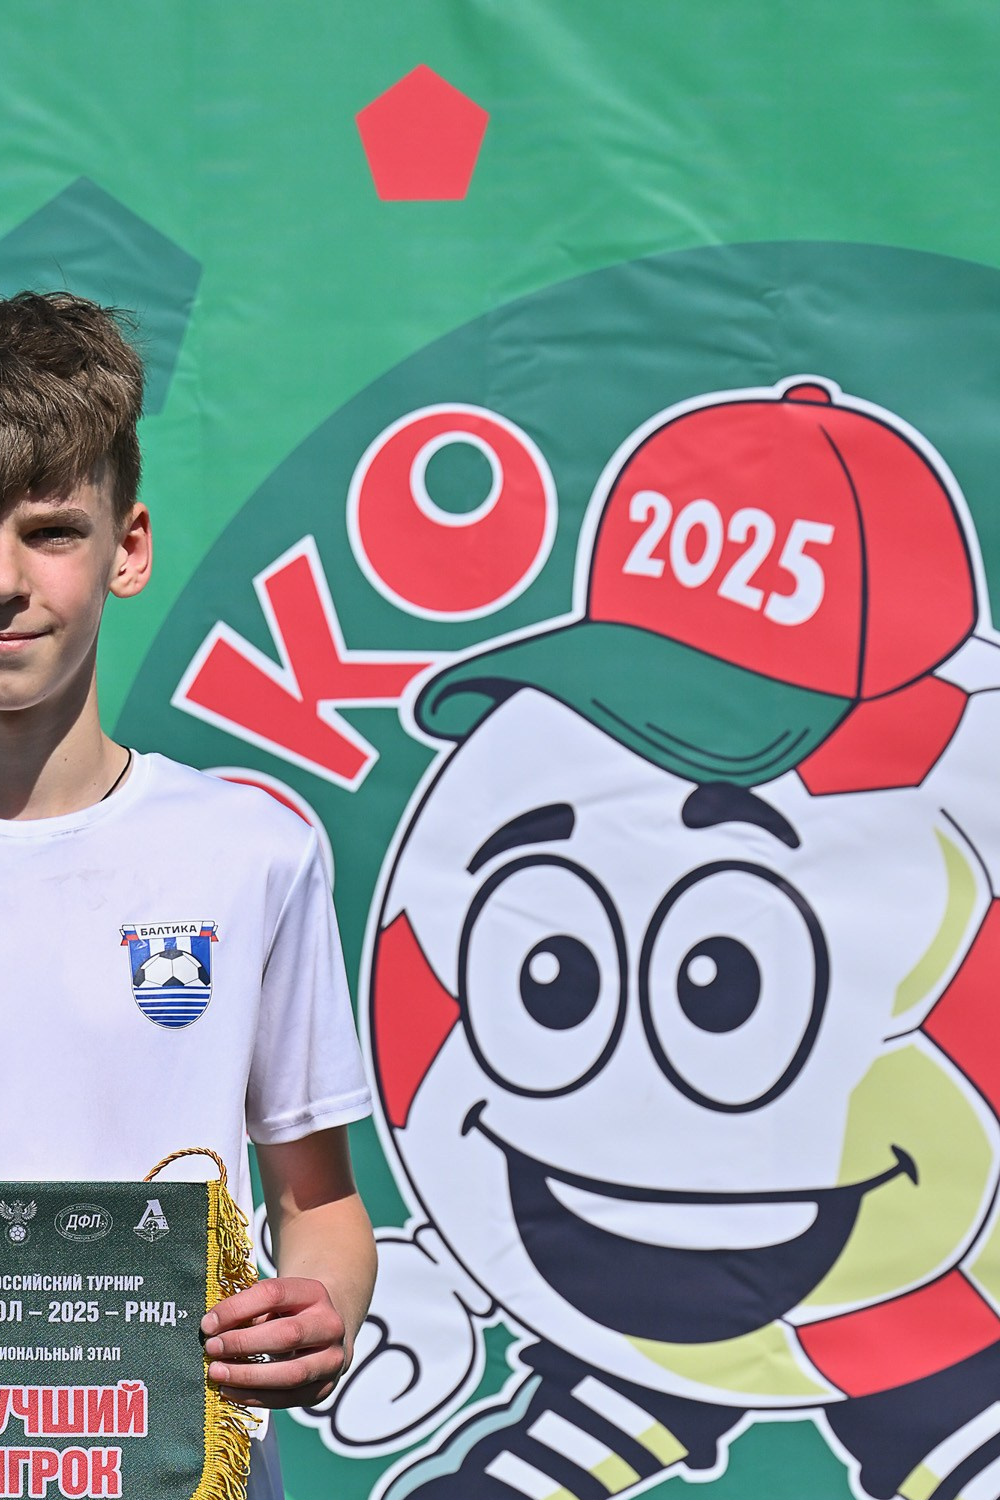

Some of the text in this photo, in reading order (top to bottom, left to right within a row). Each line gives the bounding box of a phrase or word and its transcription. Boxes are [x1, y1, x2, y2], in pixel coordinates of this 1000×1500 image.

[622, 489, 835, 626] 2025
[140, 924, 198, 937] БАЛТИКА
[66, 1214, 101, 1231] ДФЛ
[86, 1275, 144, 1292] ТУРНИР
[48, 1301, 100, 1323] 2025
[124, 1301, 189, 1326] РЖД»
[87, 1346, 121, 1362] ЭТАП
